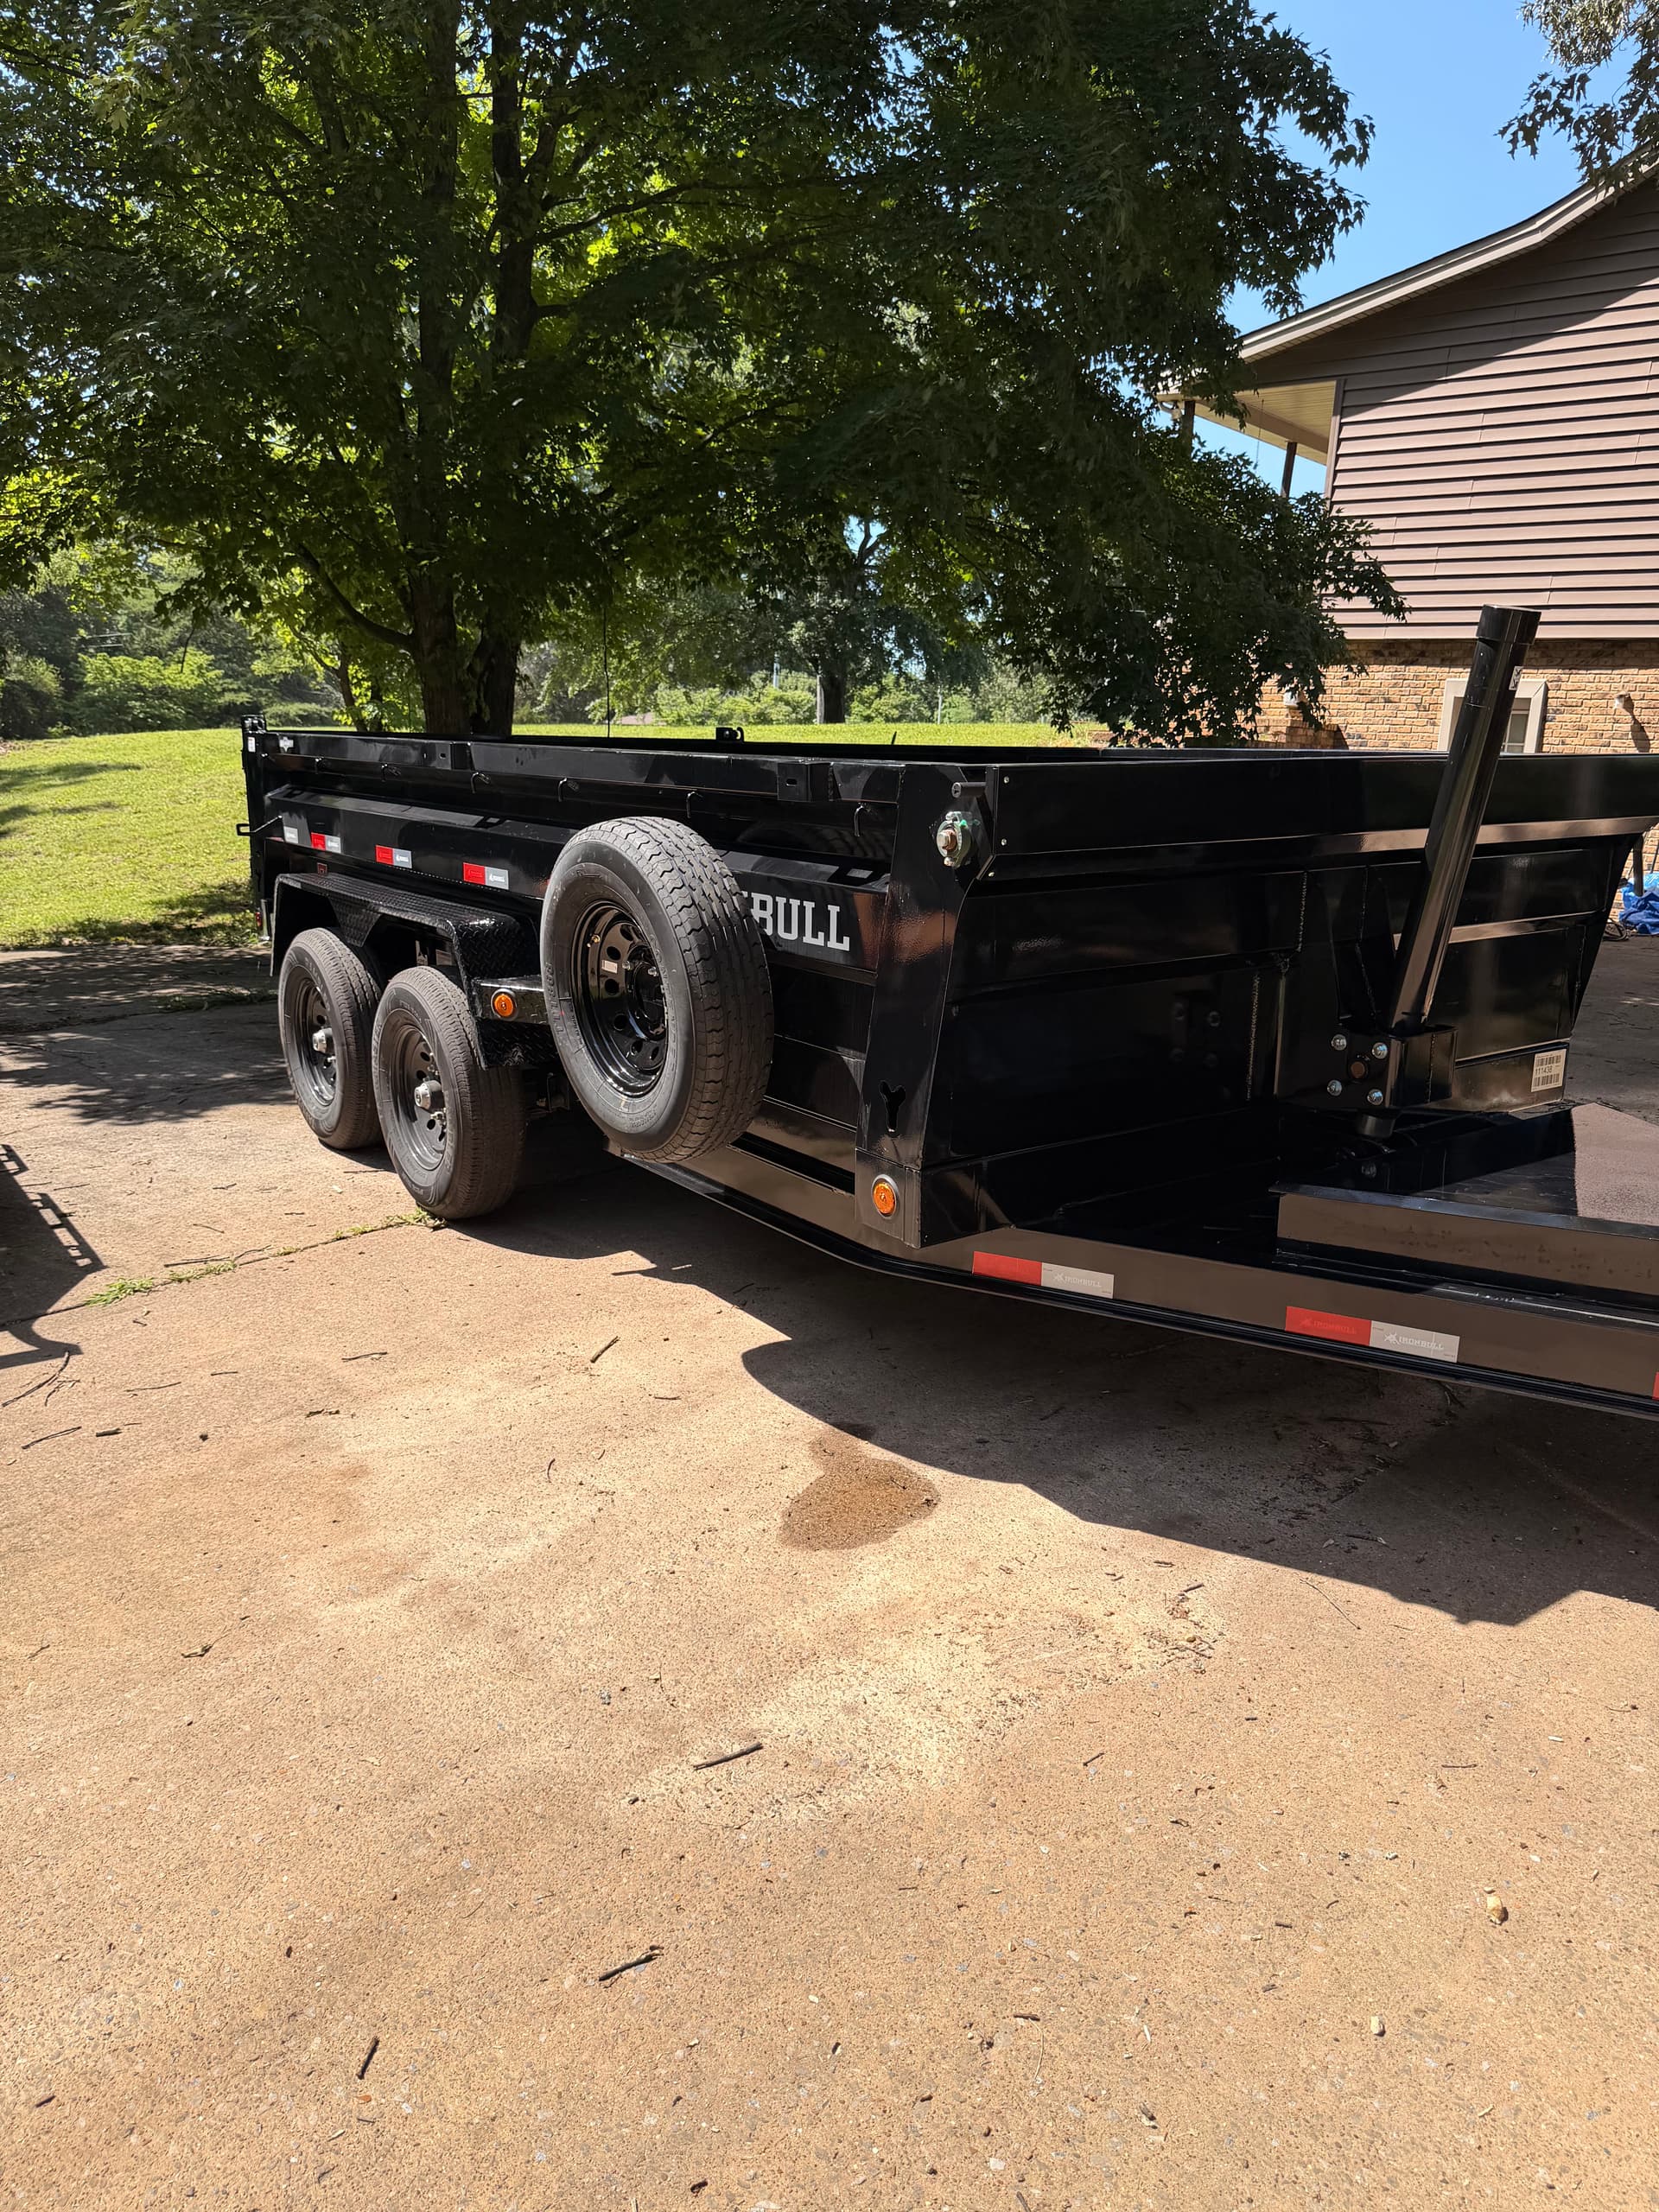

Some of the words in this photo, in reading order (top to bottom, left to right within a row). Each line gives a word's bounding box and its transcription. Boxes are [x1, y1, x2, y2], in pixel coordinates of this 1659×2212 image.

[741, 891, 850, 951] BULL
[1313, 1320, 1357, 1335] IRONBULL
[1398, 1336, 1445, 1351] IRONBULL
